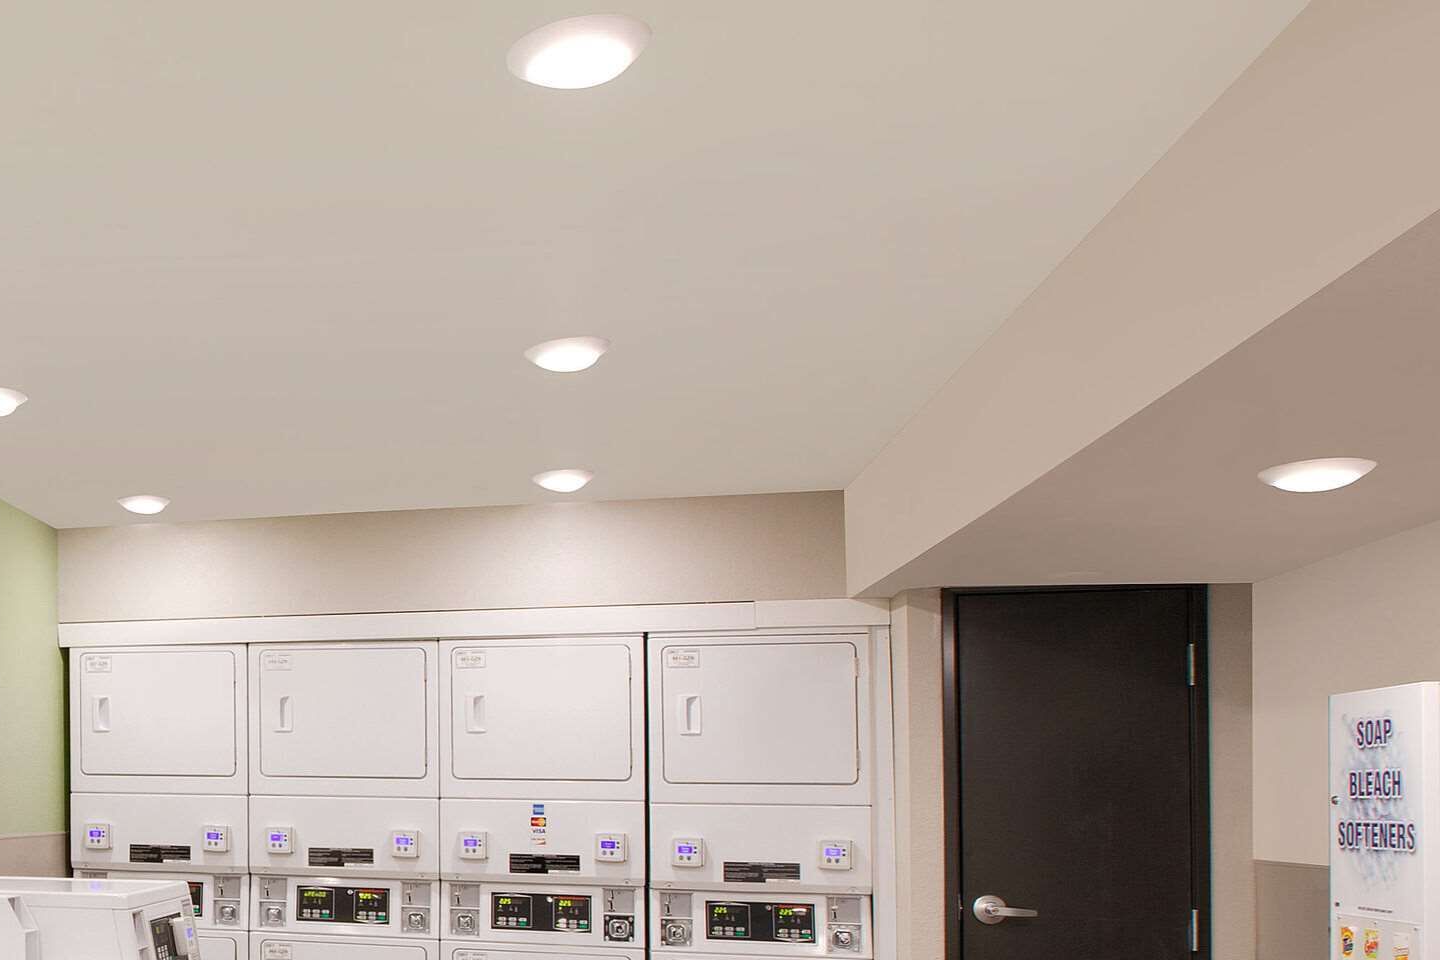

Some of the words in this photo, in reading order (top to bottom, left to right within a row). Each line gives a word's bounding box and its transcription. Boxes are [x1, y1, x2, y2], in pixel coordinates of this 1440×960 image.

[1356, 719, 1392, 747] SOAP
[1348, 770, 1402, 798] BLEACH
[1337, 821, 1416, 850] SOFTENERS
